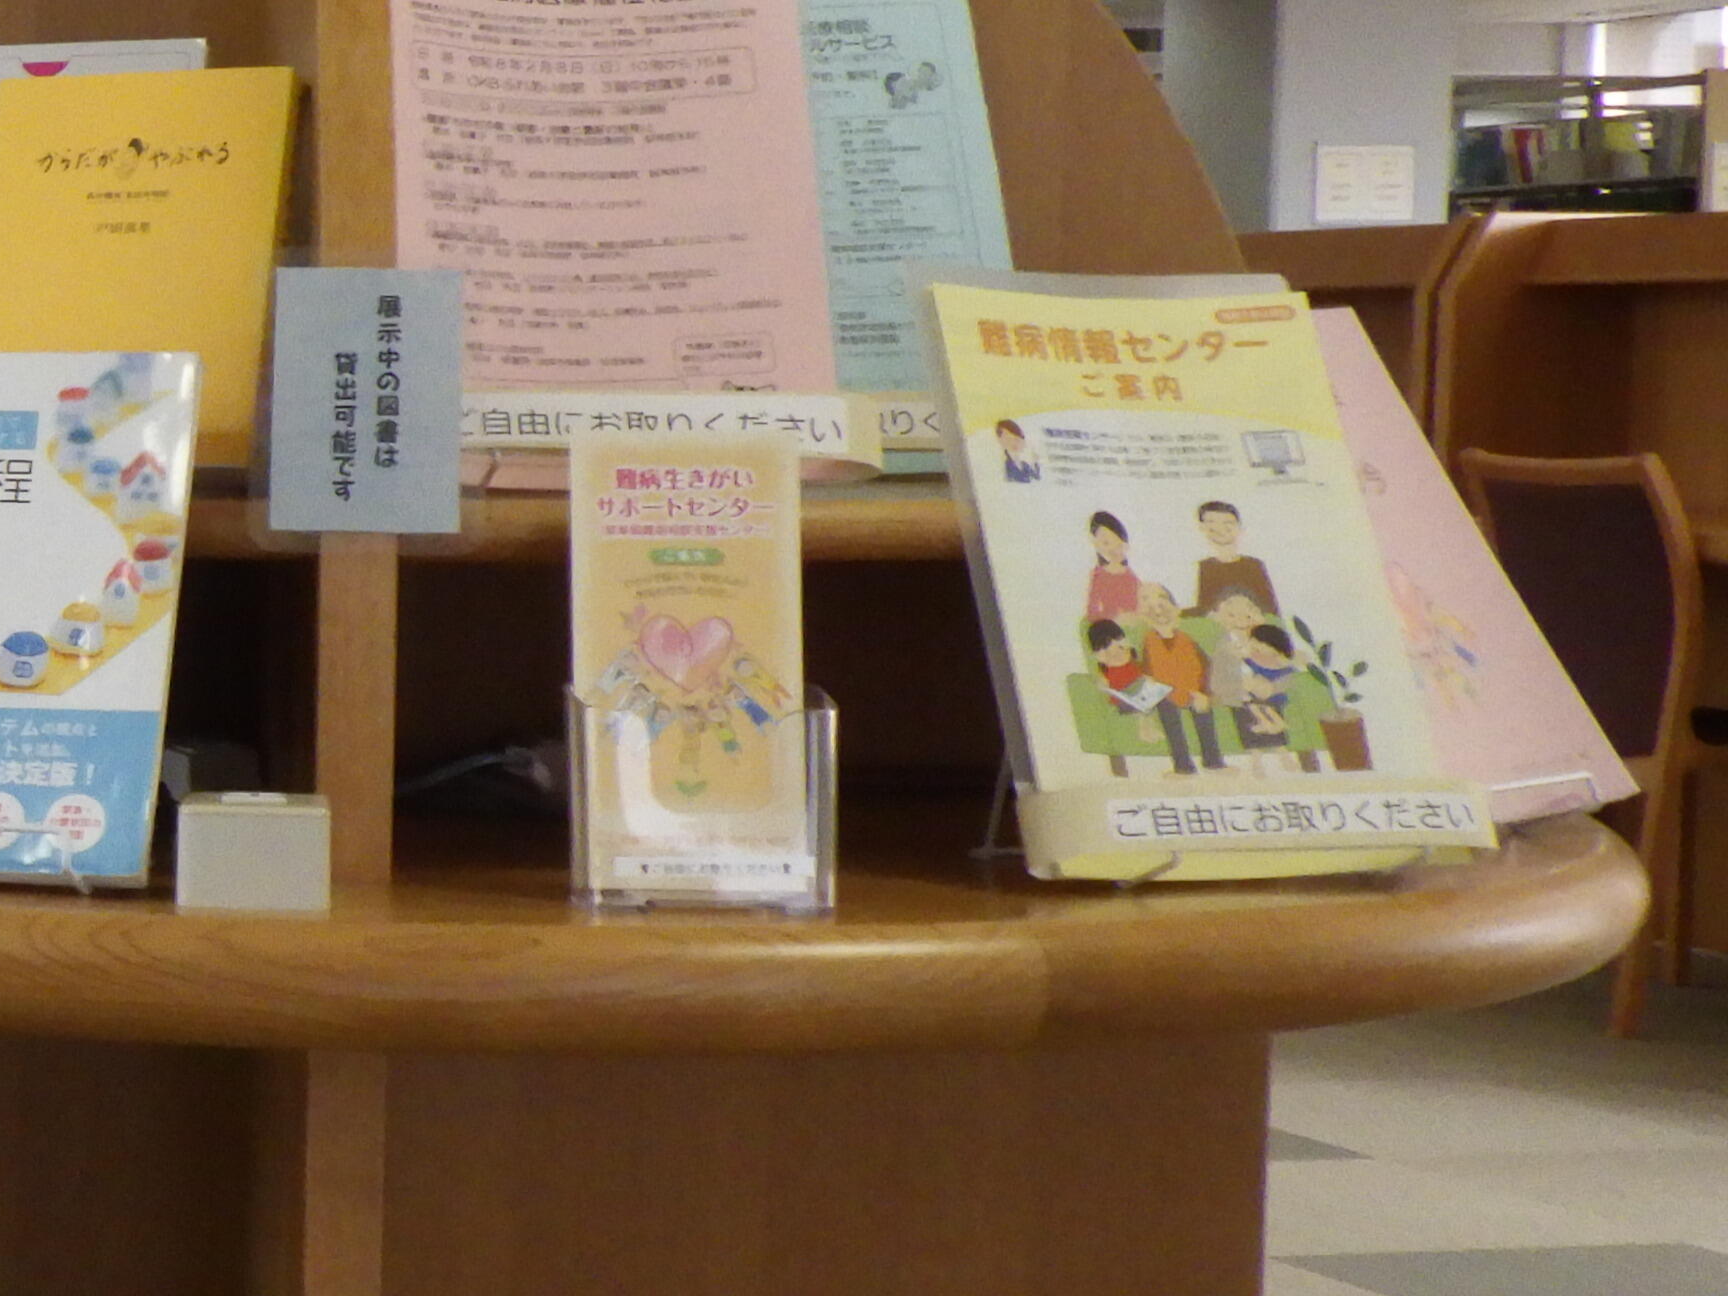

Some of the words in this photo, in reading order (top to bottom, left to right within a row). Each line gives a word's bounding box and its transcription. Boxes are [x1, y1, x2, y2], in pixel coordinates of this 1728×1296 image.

[977, 316, 1271, 365] 難病情報センター
[374, 294, 403, 469] 展示中の図書は
[1078, 371, 1185, 402] ご案内
[331, 351, 359, 502] 貸出可能です
[615, 468, 755, 491] 難病生きがい
[596, 496, 775, 519] サポートセンター
[1113, 798, 1476, 840] ご自由にお取りください
